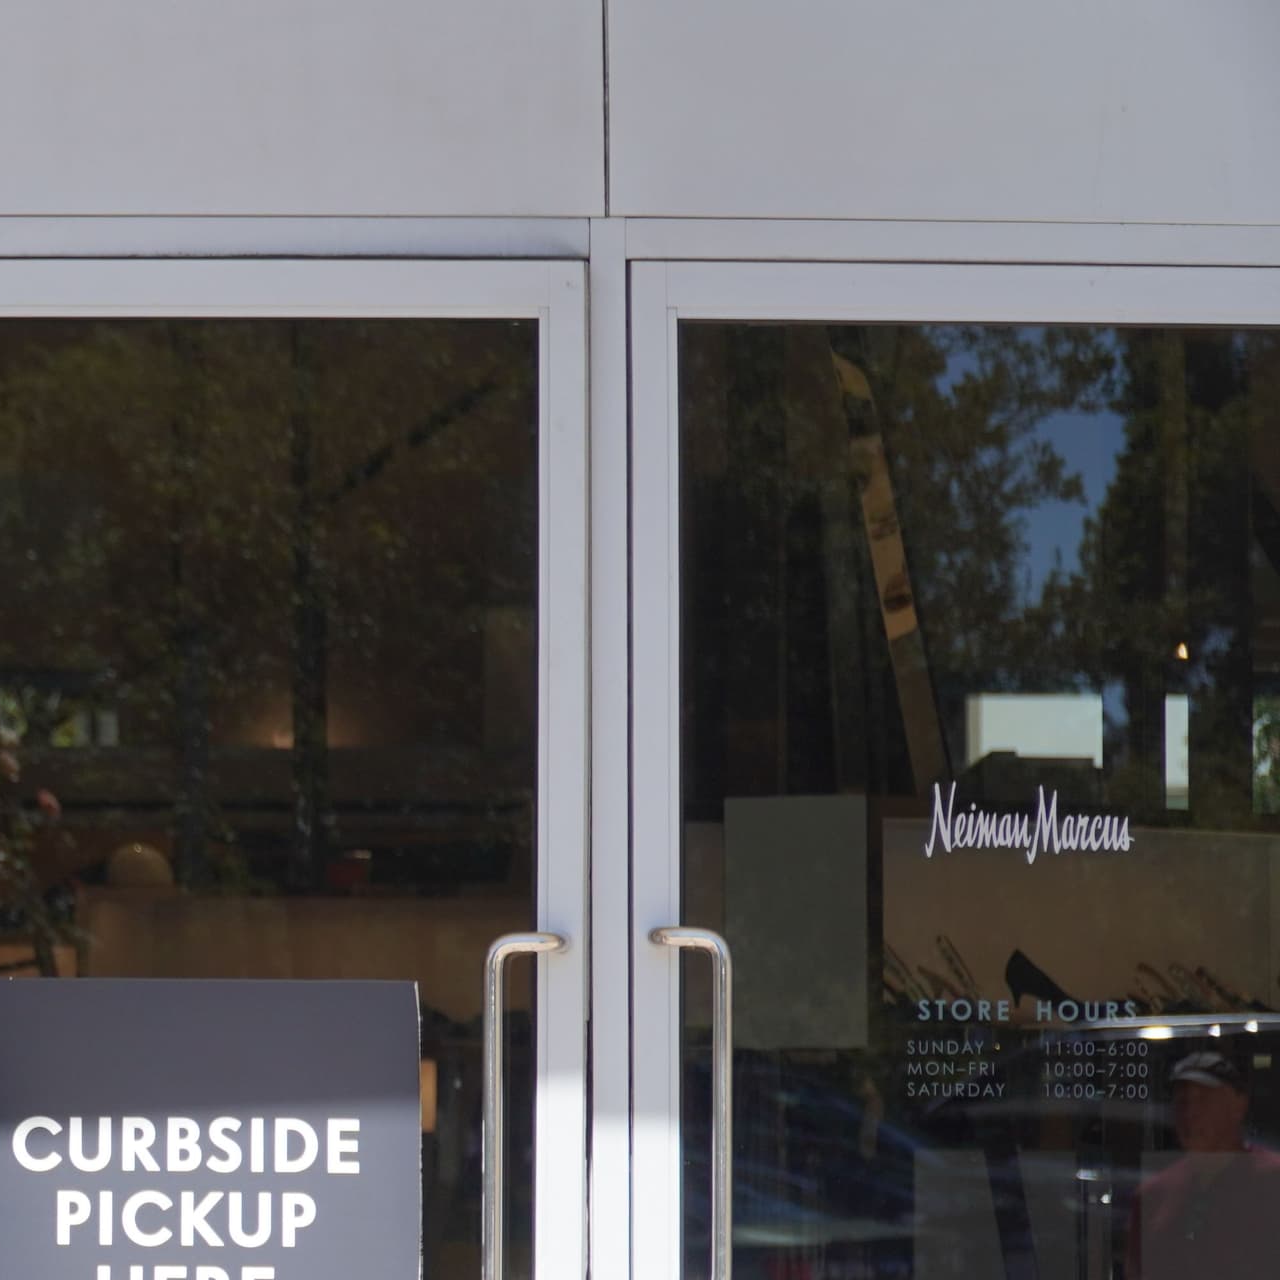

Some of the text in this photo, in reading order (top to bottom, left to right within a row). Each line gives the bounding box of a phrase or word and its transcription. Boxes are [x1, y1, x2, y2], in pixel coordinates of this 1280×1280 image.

[924, 781, 1135, 864] Neiman Marcus
[918, 1000, 1137, 1022] STORE HOURS
[907, 1040, 984, 1055] SUNDAY
[907, 1082, 1006, 1097] SATURDAY
[12, 1115, 361, 1175] CURBSIDE
[56, 1190, 318, 1248] PICKUP
